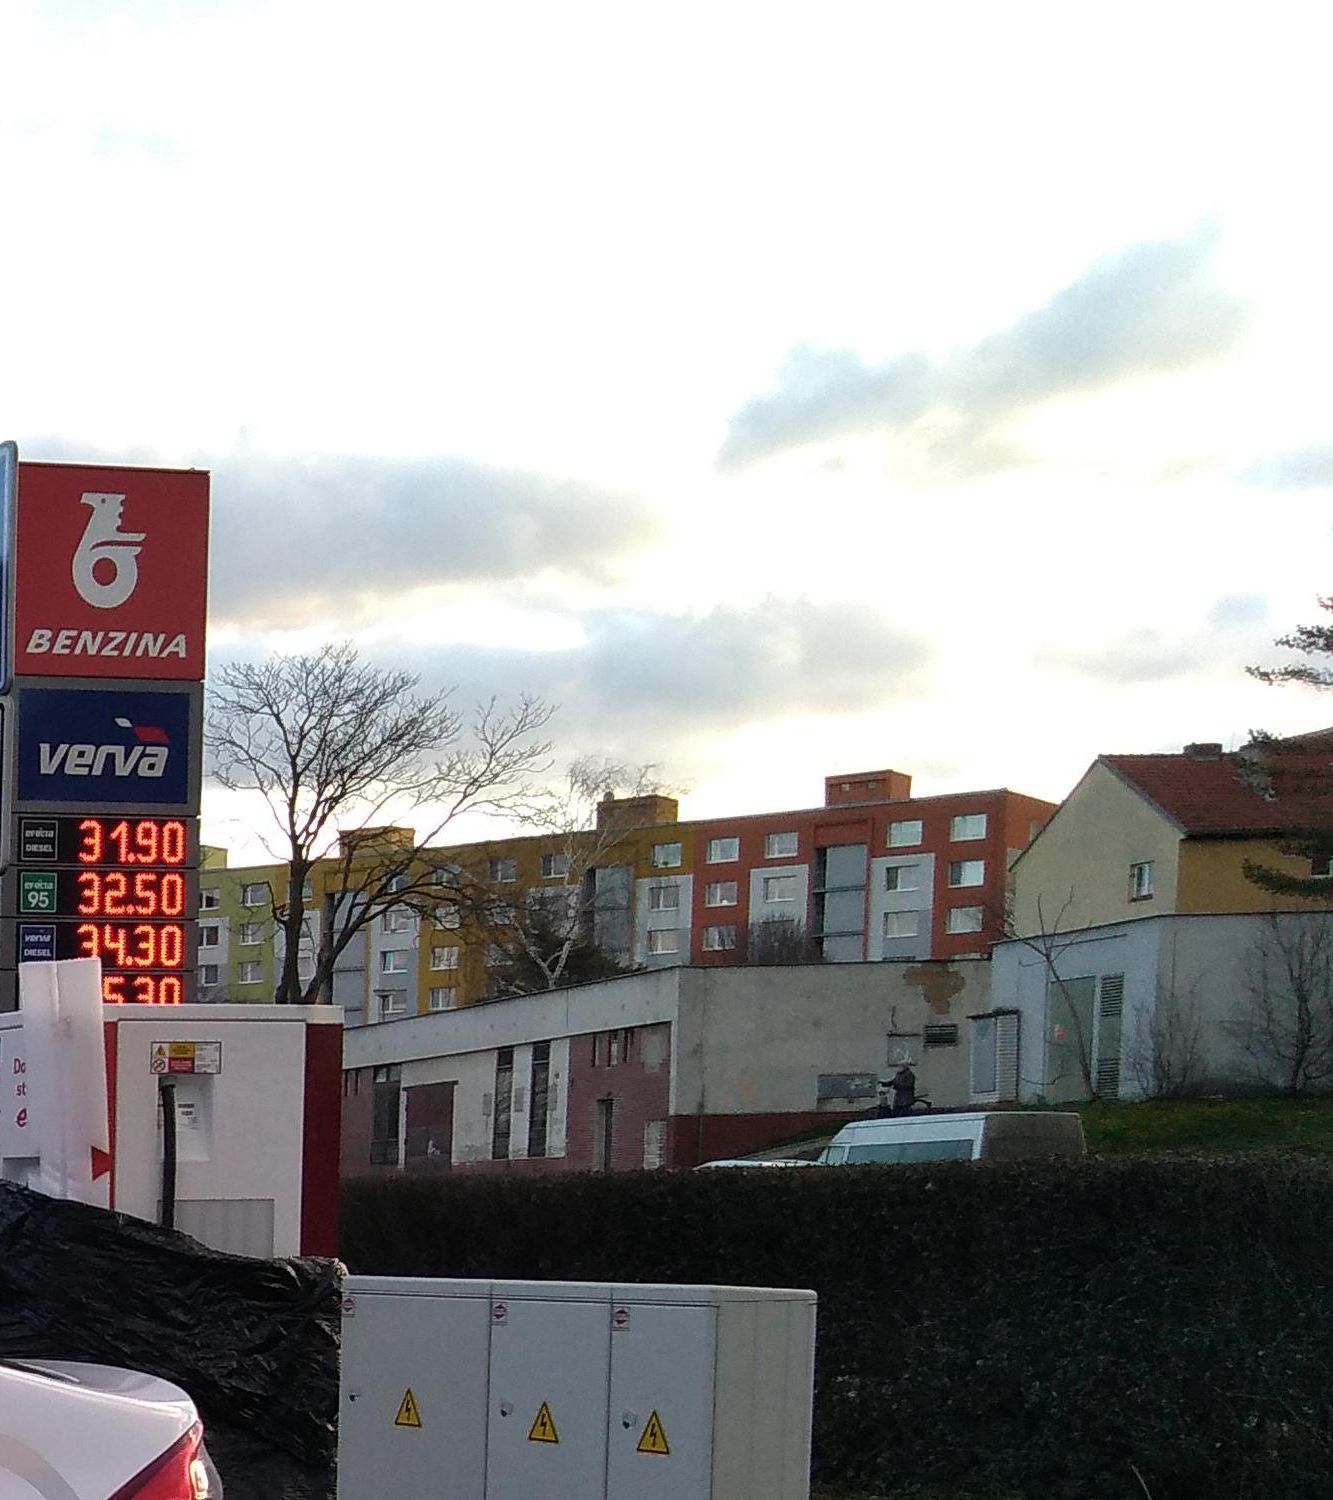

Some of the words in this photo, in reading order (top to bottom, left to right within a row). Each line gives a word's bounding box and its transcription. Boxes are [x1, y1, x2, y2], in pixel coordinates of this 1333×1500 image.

[26, 629, 188, 658] BENZINA
[39, 743, 169, 777] verva
[78, 819, 185, 864] 31.90
[27, 892, 50, 908] 95
[77, 871, 184, 915] 32.50
[24, 948, 52, 958] DIESEL
[77, 924, 183, 967] 34.30
